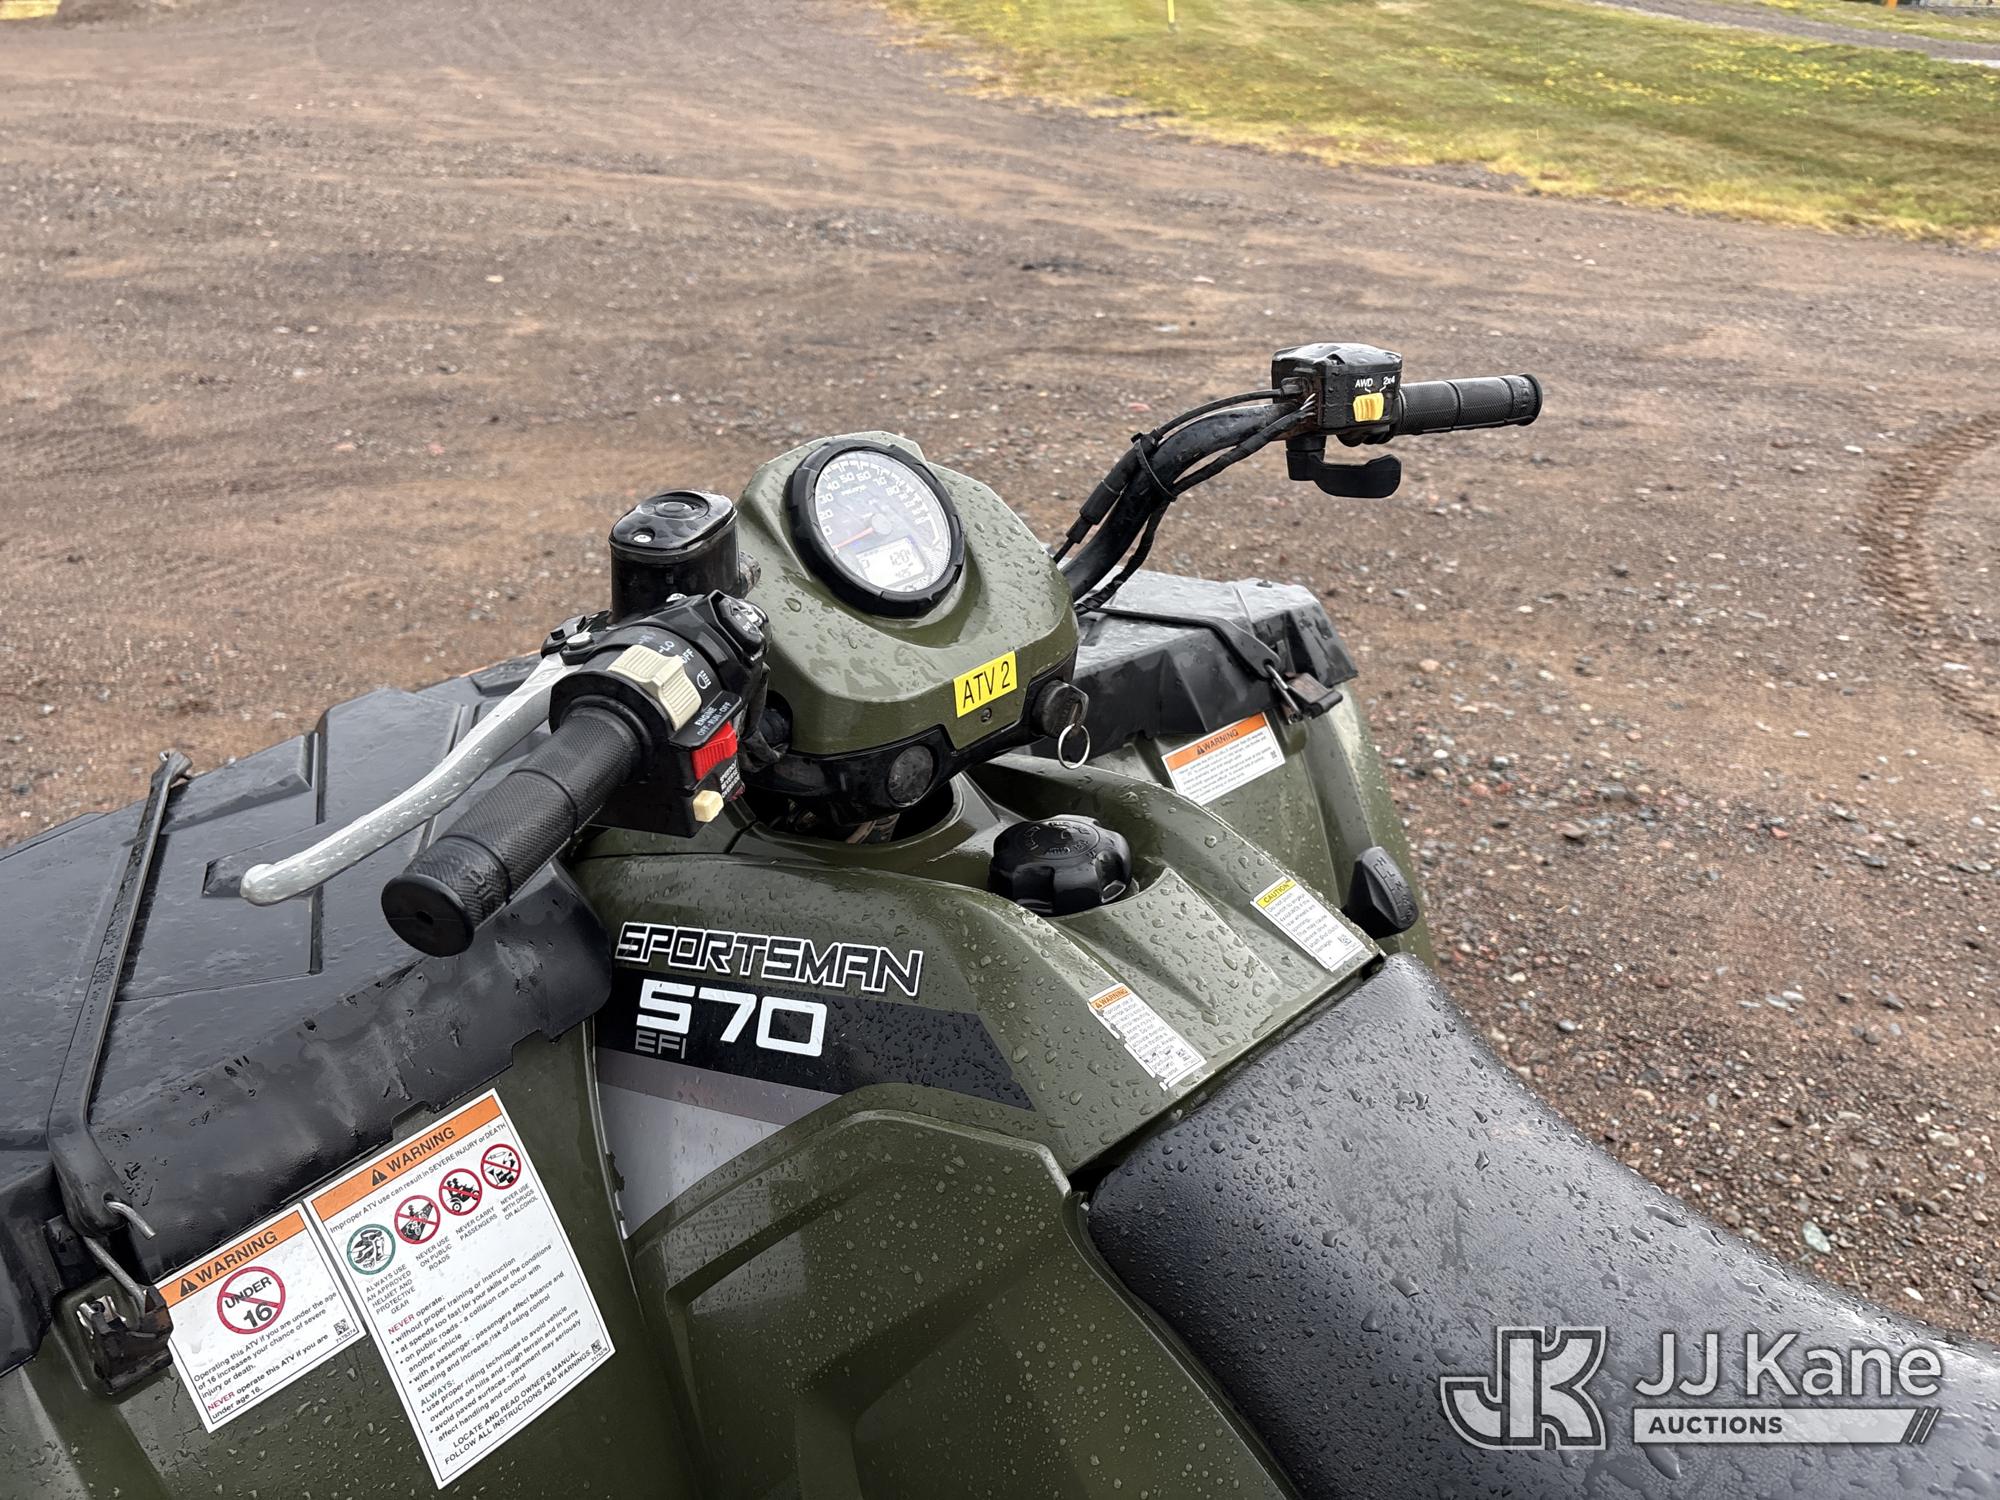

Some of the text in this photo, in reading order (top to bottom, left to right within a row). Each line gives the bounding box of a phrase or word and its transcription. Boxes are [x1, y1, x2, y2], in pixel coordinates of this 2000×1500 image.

[1355, 375, 1396, 389] AWD 2x4
[826, 480, 840, 491] 40
[839, 472, 855, 484] 50
[856, 470, 871, 482] 60
[872, 476, 887, 487] 70
[886, 485, 900, 496] 80
[818, 493, 834, 505] 30
[818, 508, 834, 521] 20
[963, 661, 1011, 709] ATV 2
[694, 706, 717, 726] ENGINE
[1203, 728, 1239, 750] WARNING
[1263, 883, 1289, 903] CAUTION
[614, 922, 923, 996] SPORTSMAN
[1101, 988, 1128, 1007] WARNING
[636, 978, 827, 1057] 570
[635, 1029, 687, 1059] EFI
[386, 1126, 456, 1173] WARNING
[329, 1122, 506, 1234] Improper ATV use can result SEVERE INJURY DEATH
[500, 1183, 529, 1205] NEVER USE
[502, 1189, 535, 1213] WITH DRUGS
[513, 1195, 538, 1215] ALCOHOL
[455, 1206, 494, 1235] NEVER CARRY
[459, 1213, 498, 1241] PASSENGERS
[195, 1230, 279, 1284] WARNING
[415, 1235, 450, 1261] NEVER USE
[428, 1253, 450, 1271] ROADS
[429, 1243, 452, 1261] PUBLIC
[224, 1276, 272, 1309] UNDER
[366, 1263, 407, 1294] ALWAYS USE
[372, 1278, 413, 1308] HELMET AND
[377, 1270, 412, 1296] APPROVED
[375, 1285, 416, 1315] PROTECTIVE
[390, 1299, 410, 1314] GEAR
[395, 1257, 516, 1342] without proper training instruction
[408, 1244, 552, 1347] speeds too fast for your skills the conditions
[415, 1264, 542, 1357] public roads collision can occur with
[243, 1302, 274, 1329] 16
[388, 1295, 445, 1335] NEVER operate:
[413, 1270, 565, 1382] with passenger passengers affect balance and
[193, 1292, 337, 1382] Operating this ATV you are under the age
[207, 1309, 326, 1385] 16 increases your chance severe
[417, 1293, 551, 1393] steering and increase risk losing control
[408, 1333, 462, 1373] another vehicle
[426, 1306, 567, 1412] use proper riding techniques avoid vehicle
[430, 1309, 579, 1422] overturns hills and rough terrain and turns
[201, 1364, 256, 1399] injury death.
[207, 1391, 235, 1411] NEVER
[236, 1374, 265, 1394] operate
[265, 1365, 280, 1376] this
[281, 1354, 295, 1367] ATV
[302, 1342, 316, 1354] you
[317, 1334, 328, 1344] are
[434, 1319, 581, 1432] avoid paved surfaces pavement may seriously
[212, 1386, 262, 1419] under age 16.
[421, 1379, 455, 1407] ALWAYS:
[438, 1373, 527, 1442] affect handling and control
[444, 1437, 476, 1465] FOLLOW
[478, 1428, 493, 1441] ALL
[492, 1388, 543, 1430] INSTRUCTIONS
[543, 1377, 557, 1392] AND
[557, 1349, 592, 1379] WARNINGS.
[453, 1422, 484, 1448] LOCATE
[484, 1410, 500, 1426] AND
[500, 1395, 520, 1414] READ
[520, 1371, 552, 1398] OWNER'S
[551, 1350, 580, 1374] MANUAL.
